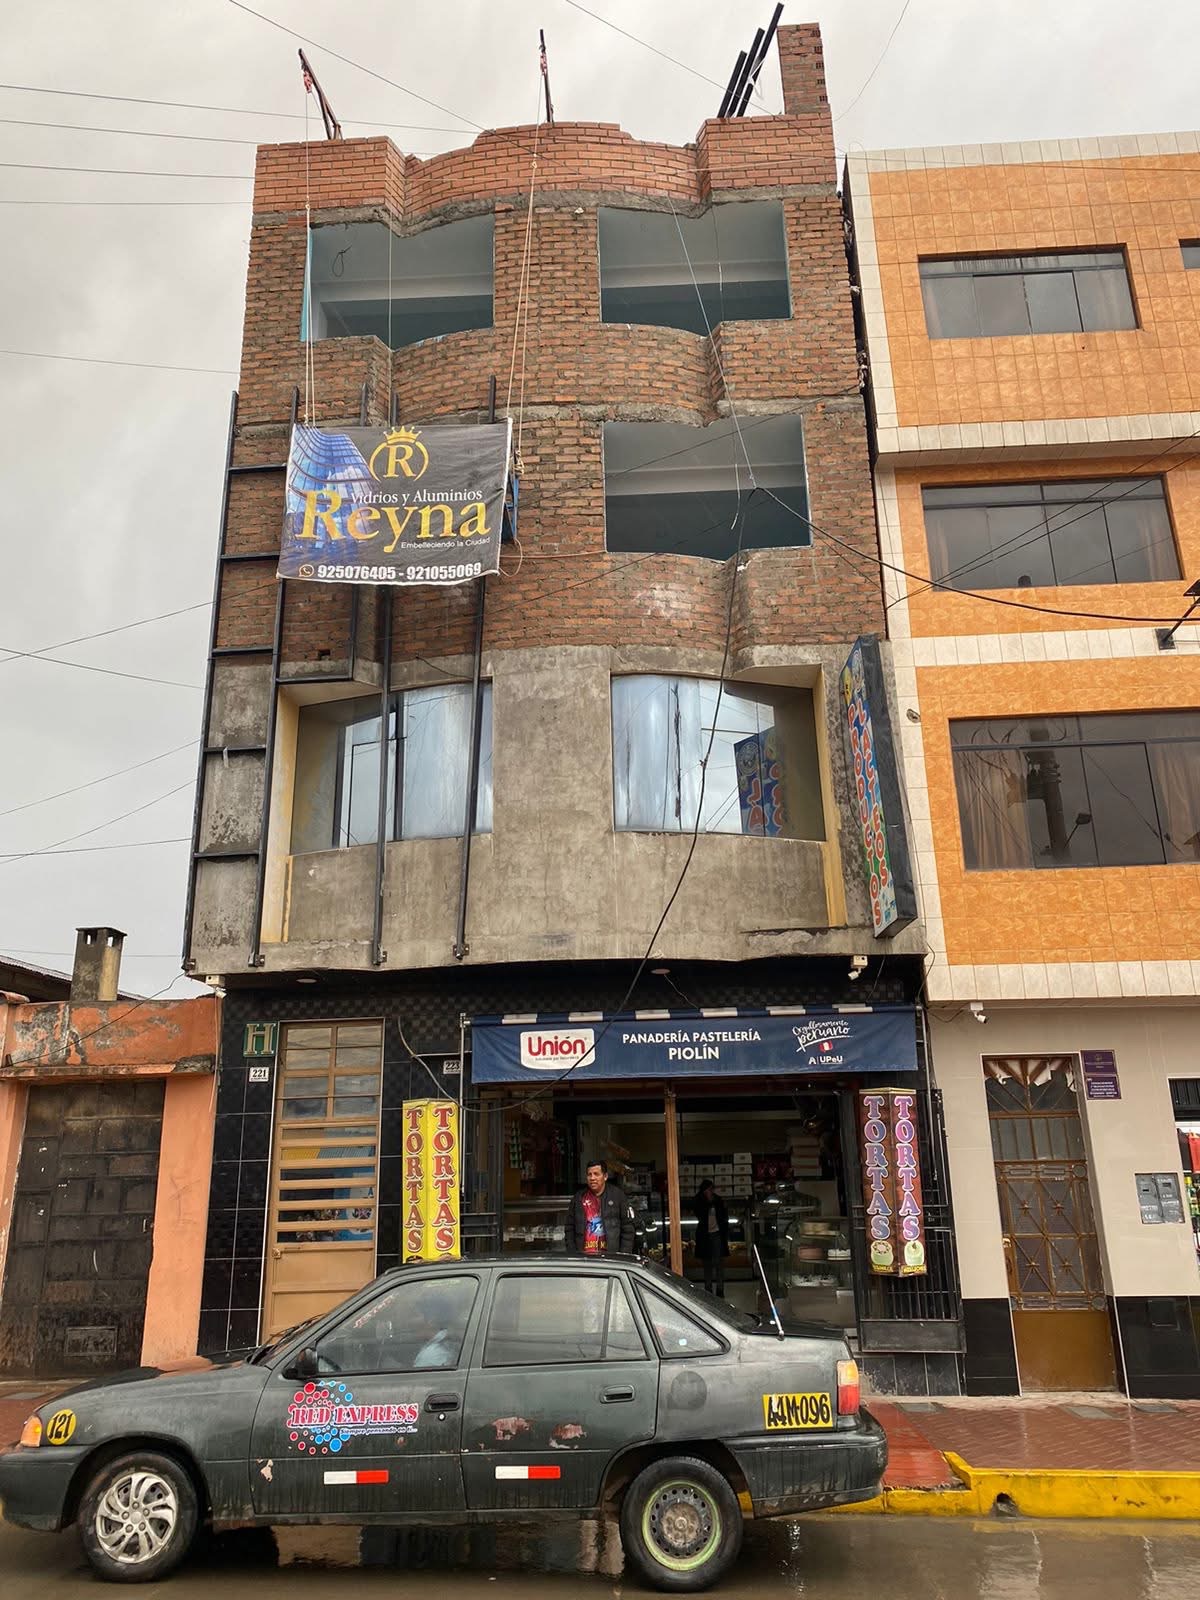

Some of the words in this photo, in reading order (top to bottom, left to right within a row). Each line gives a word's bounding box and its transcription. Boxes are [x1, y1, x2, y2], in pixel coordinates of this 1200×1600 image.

[383, 444, 417, 478] R
[350, 490, 398, 505] Vidrios
[401, 493, 411, 506] y
[413, 489, 483, 504] Aluminios
[295, 489, 491, 553] Reyna
[401, 540, 455, 550] Embelleciendo
[456, 539, 464, 548] la
[464, 536, 491, 547] Ciudad
[317, 564, 396, 580] 925076405
[406, 562, 482, 580] 921055069
[847, 703, 882, 927] PRODUCTOS
[527, 1035, 586, 1057] Unión
[622, 1030, 690, 1044] PANADERÍA
[693, 1028, 761, 1043] PASTELERÍA
[668, 1043, 720, 1060] PIOLÍN
[252, 1069, 267, 1078] 221
[445, 1061, 460, 1070] 223
[404, 1107, 424, 1252] TORTAS
[432, 1106, 457, 1251] TORTAS
[863, 1095, 892, 1241] TORTAS
[894, 1095, 921, 1241] TORTAS
[48, 1412, 74, 1440] 121
[291, 1406, 332, 1427] RED
[334, 1403, 419, 1426] EXPRESS
